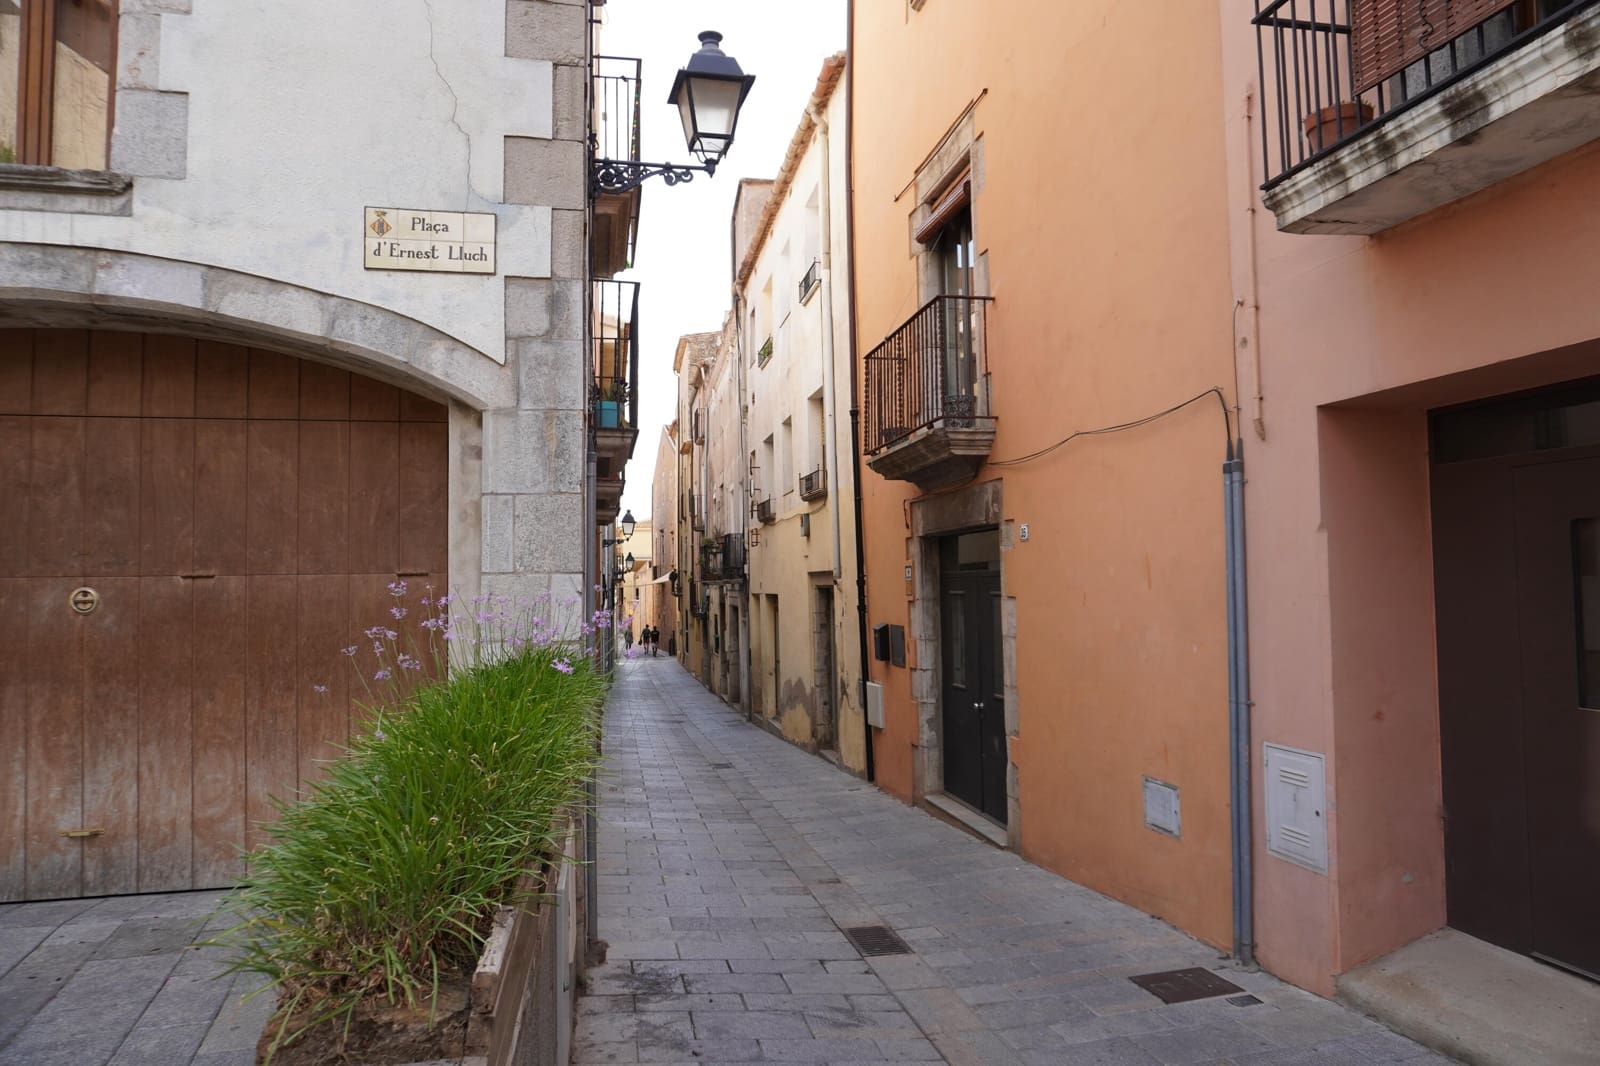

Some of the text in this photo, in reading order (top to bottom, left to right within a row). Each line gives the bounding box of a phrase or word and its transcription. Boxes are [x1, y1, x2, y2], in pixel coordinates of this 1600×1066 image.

[411, 217, 449, 234] Plaça
[373, 241, 488, 262] d'Ernest Lluch
